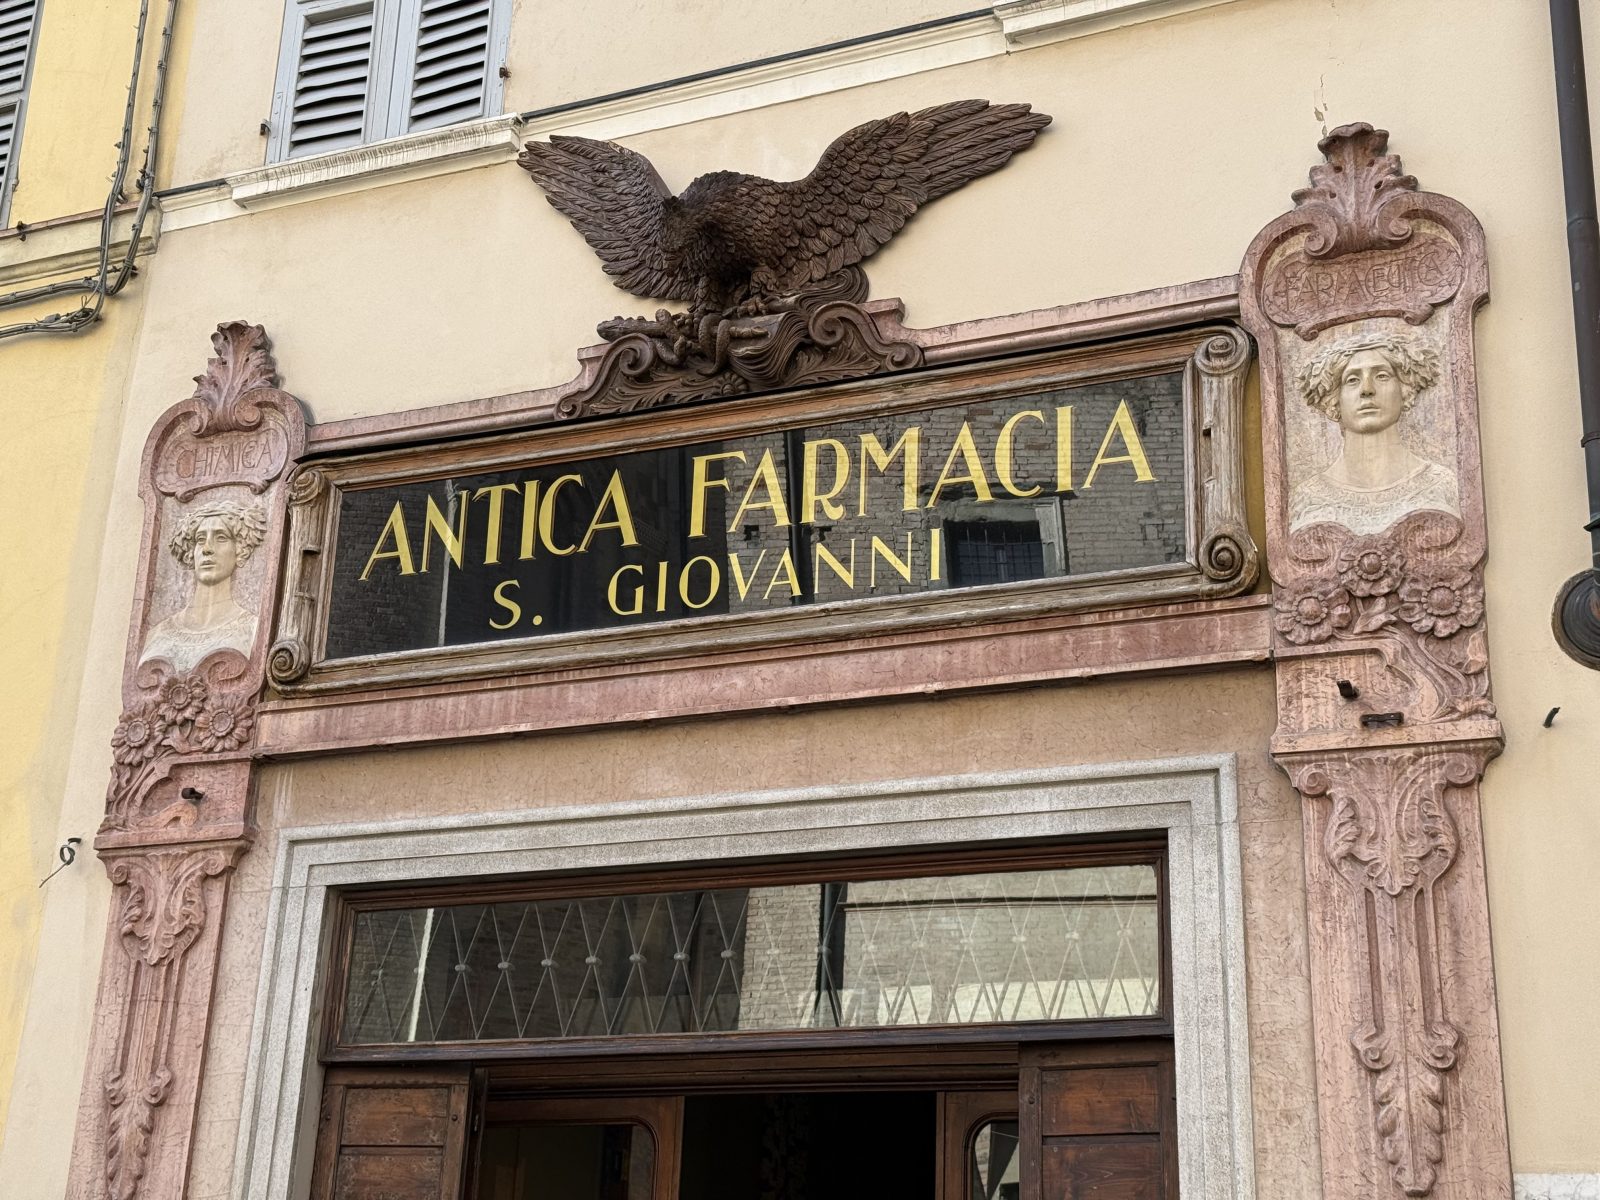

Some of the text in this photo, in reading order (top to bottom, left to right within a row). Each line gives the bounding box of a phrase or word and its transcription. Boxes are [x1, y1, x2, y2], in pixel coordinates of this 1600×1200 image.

[175, 438, 275, 479] CHIMICA
[358, 398, 1156, 582] ANTICA FARMACIA
[488, 528, 942, 631] S. GIOVANNI
